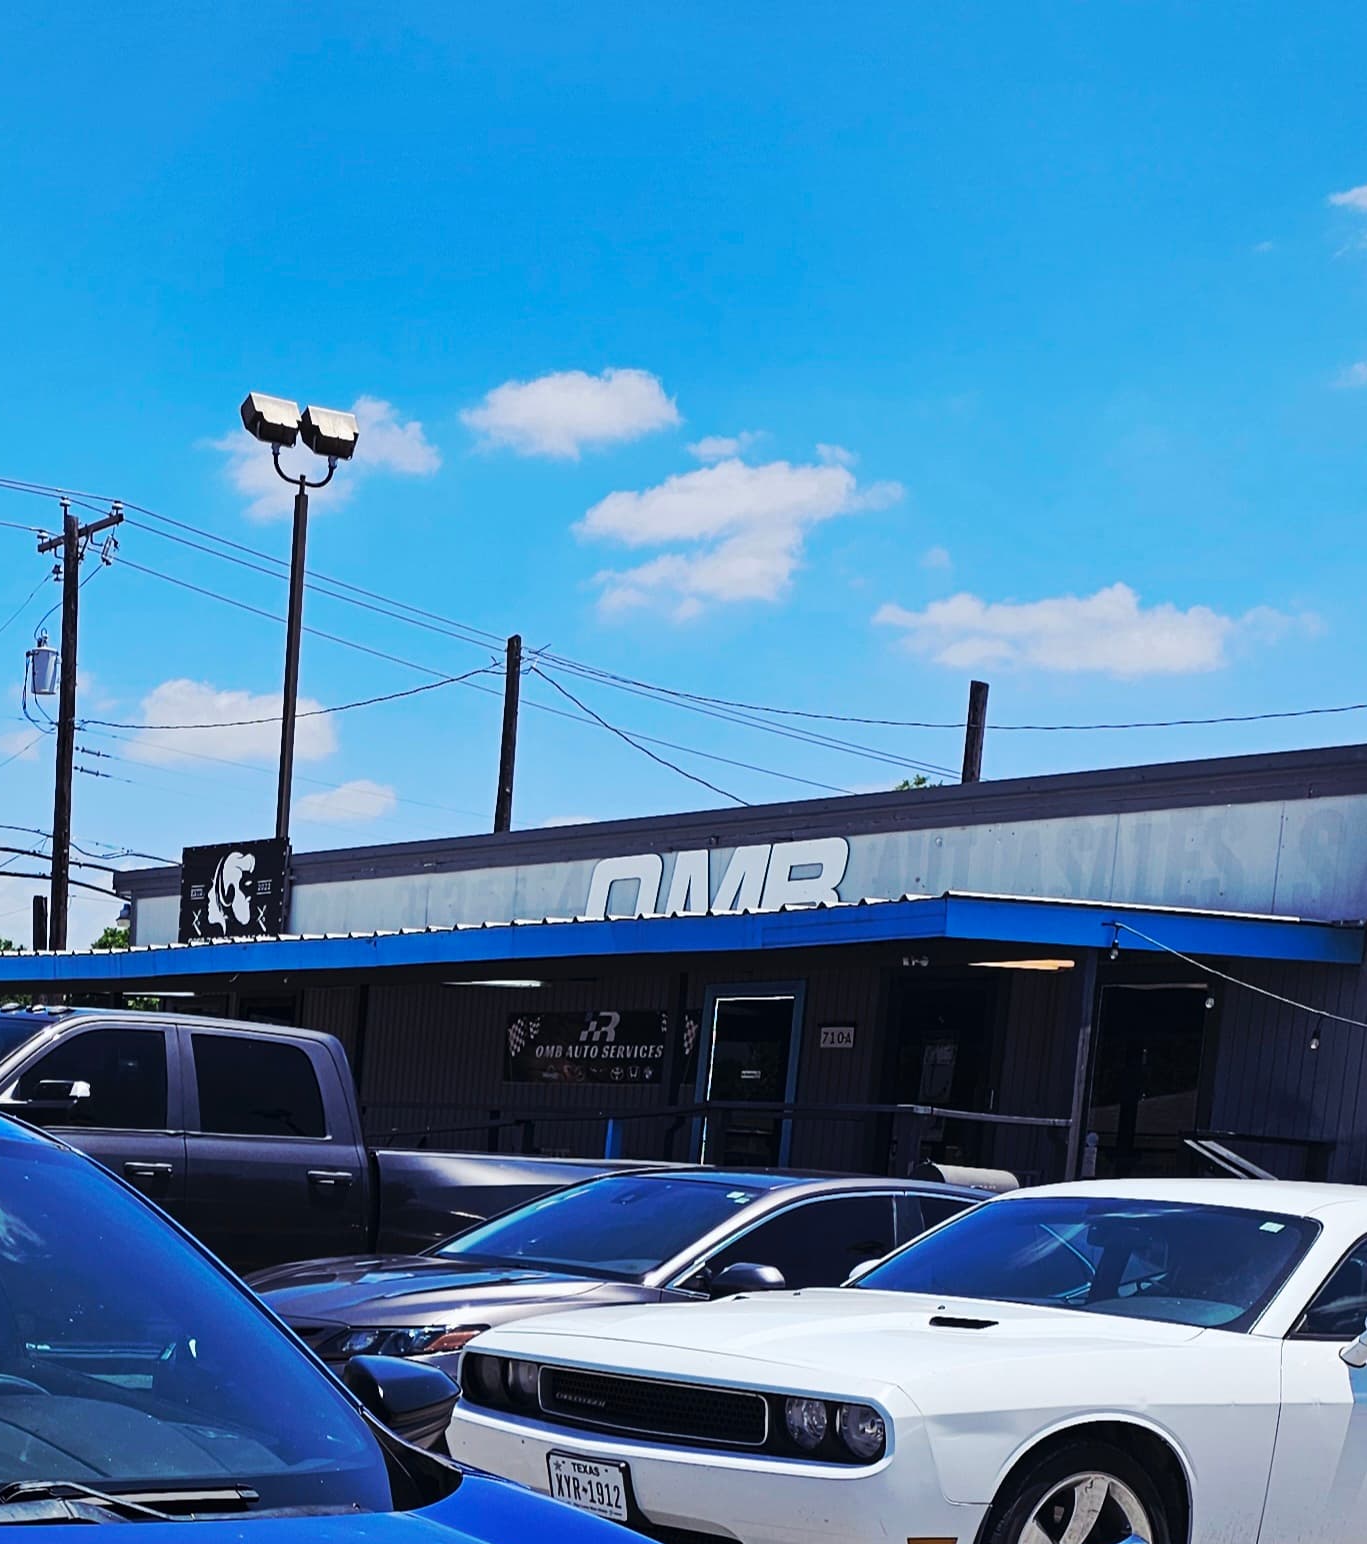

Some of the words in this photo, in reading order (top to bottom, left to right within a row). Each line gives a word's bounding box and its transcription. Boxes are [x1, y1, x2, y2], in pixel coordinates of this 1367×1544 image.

[585, 837, 849, 918] OMB
[535, 1045, 564, 1059] OMB
[566, 1045, 599, 1059] AUTO
[601, 1044, 664, 1059] SERVICES
[571, 1462, 600, 1477] TEXAS
